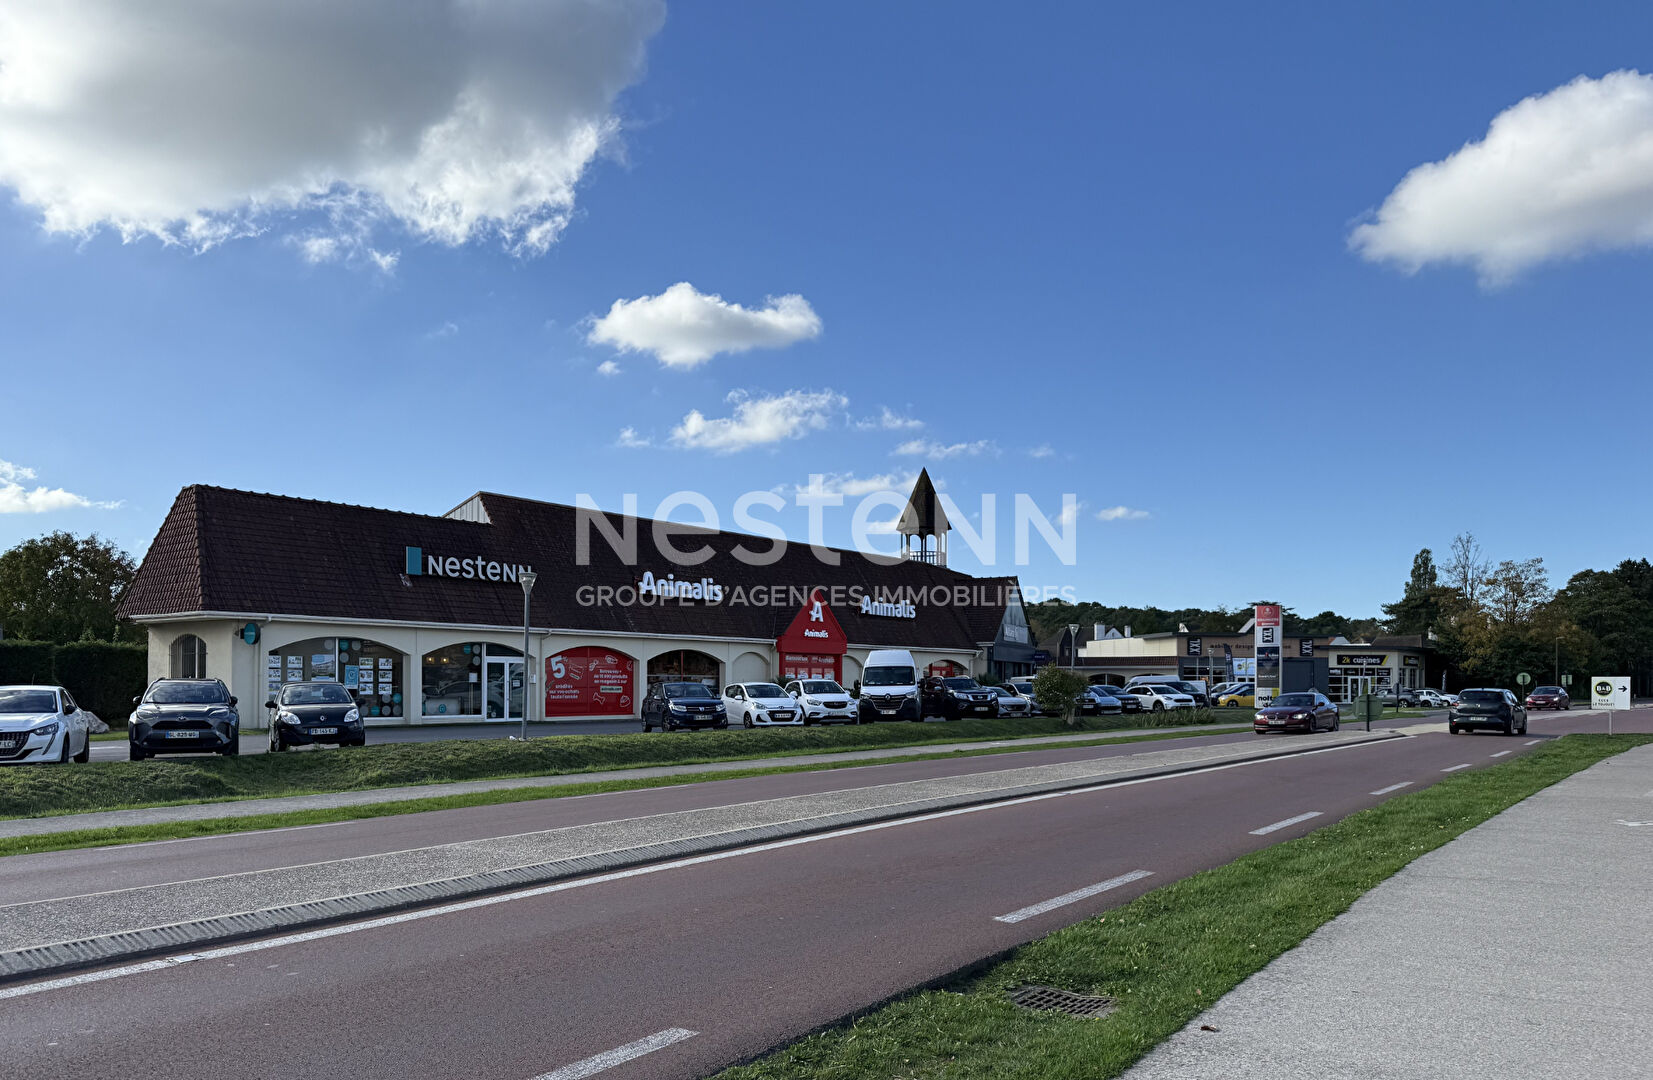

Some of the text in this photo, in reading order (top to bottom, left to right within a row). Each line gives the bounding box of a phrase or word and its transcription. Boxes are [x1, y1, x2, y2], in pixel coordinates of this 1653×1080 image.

[637, 570, 724, 602] Animalis
[859, 594, 917, 619] Animalis
[803, 628, 829, 639] Animalis
[1189, 638, 1201, 655] XXL
[1302, 640, 1313, 656] XXL
